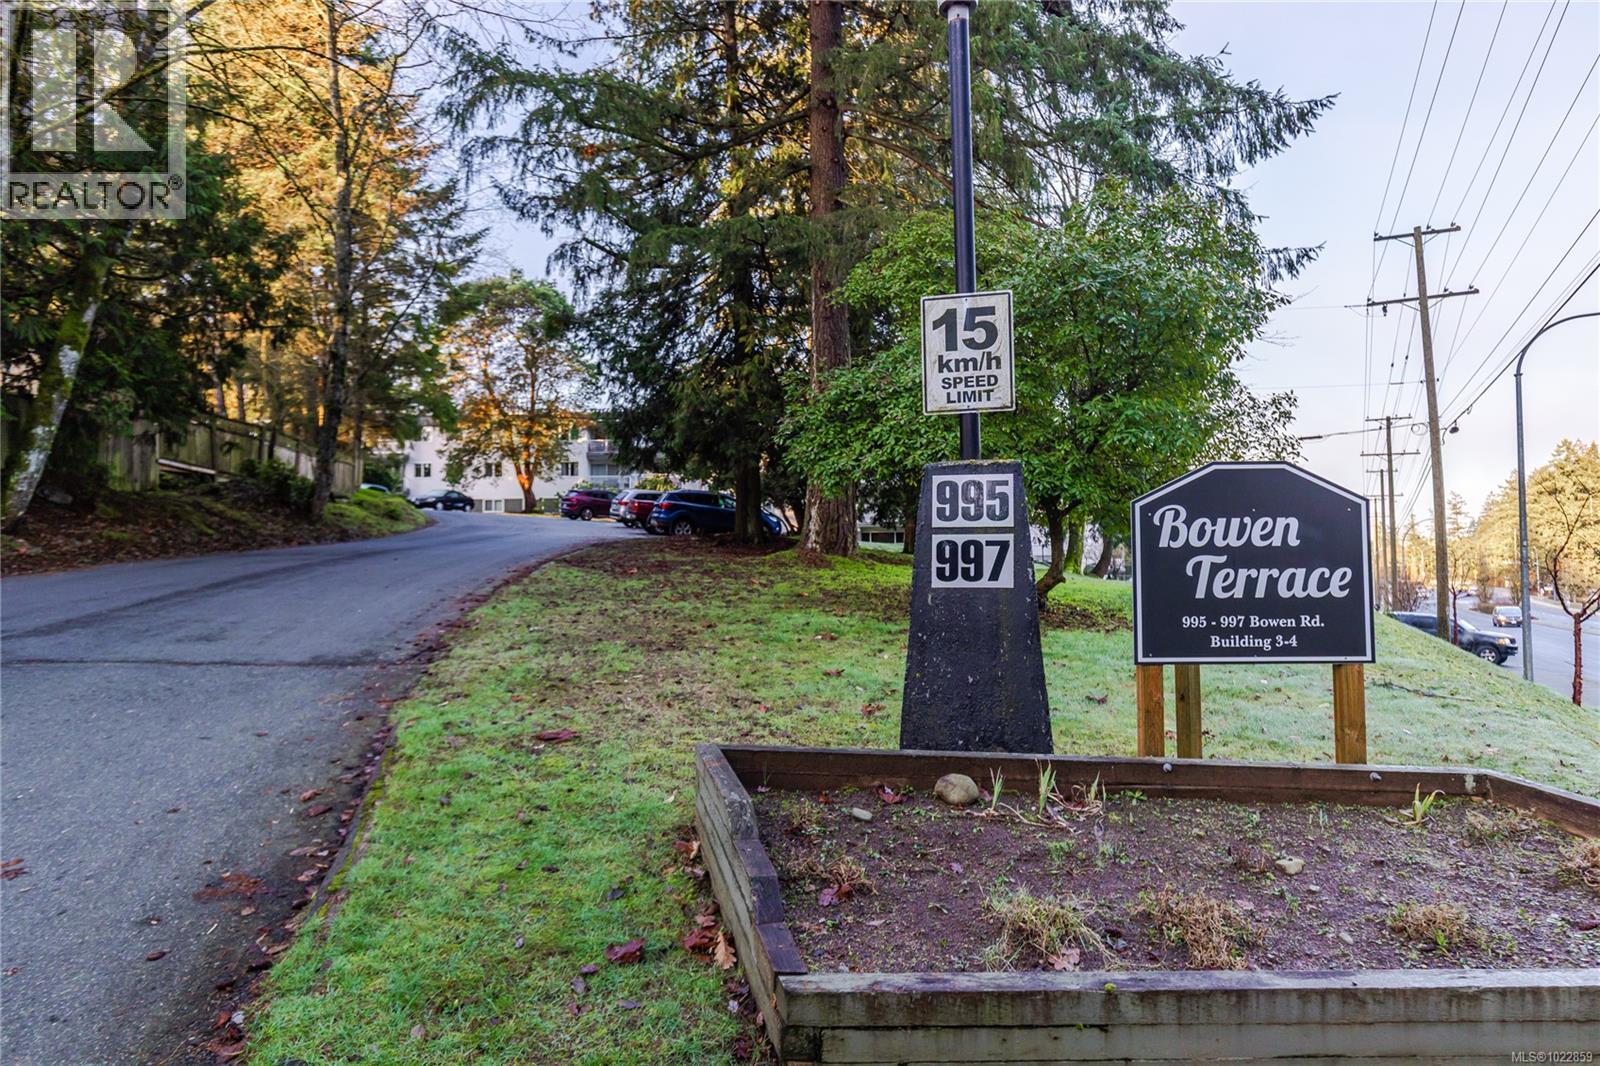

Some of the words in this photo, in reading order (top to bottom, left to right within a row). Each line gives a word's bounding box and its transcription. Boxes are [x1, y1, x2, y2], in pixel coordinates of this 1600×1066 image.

[932, 305, 999, 352] 15
[938, 351, 1002, 374] km/h
[941, 374, 999, 390] SPEED
[946, 389, 995, 404] LIMIT
[936, 479, 1010, 522] 995
[1153, 504, 1301, 548] Bowen
[935, 539, 1010, 582] 997
[1185, 554, 1353, 600] Terrace
[1182, 615, 1207, 628] 995
[1220, 615, 1245, 628] 997
[1249, 615, 1296, 628] Bowen
[1300, 614, 1325, 628] Rd.
[1210, 635, 1272, 650] Building
[1275, 635, 1298, 648] 3-4
